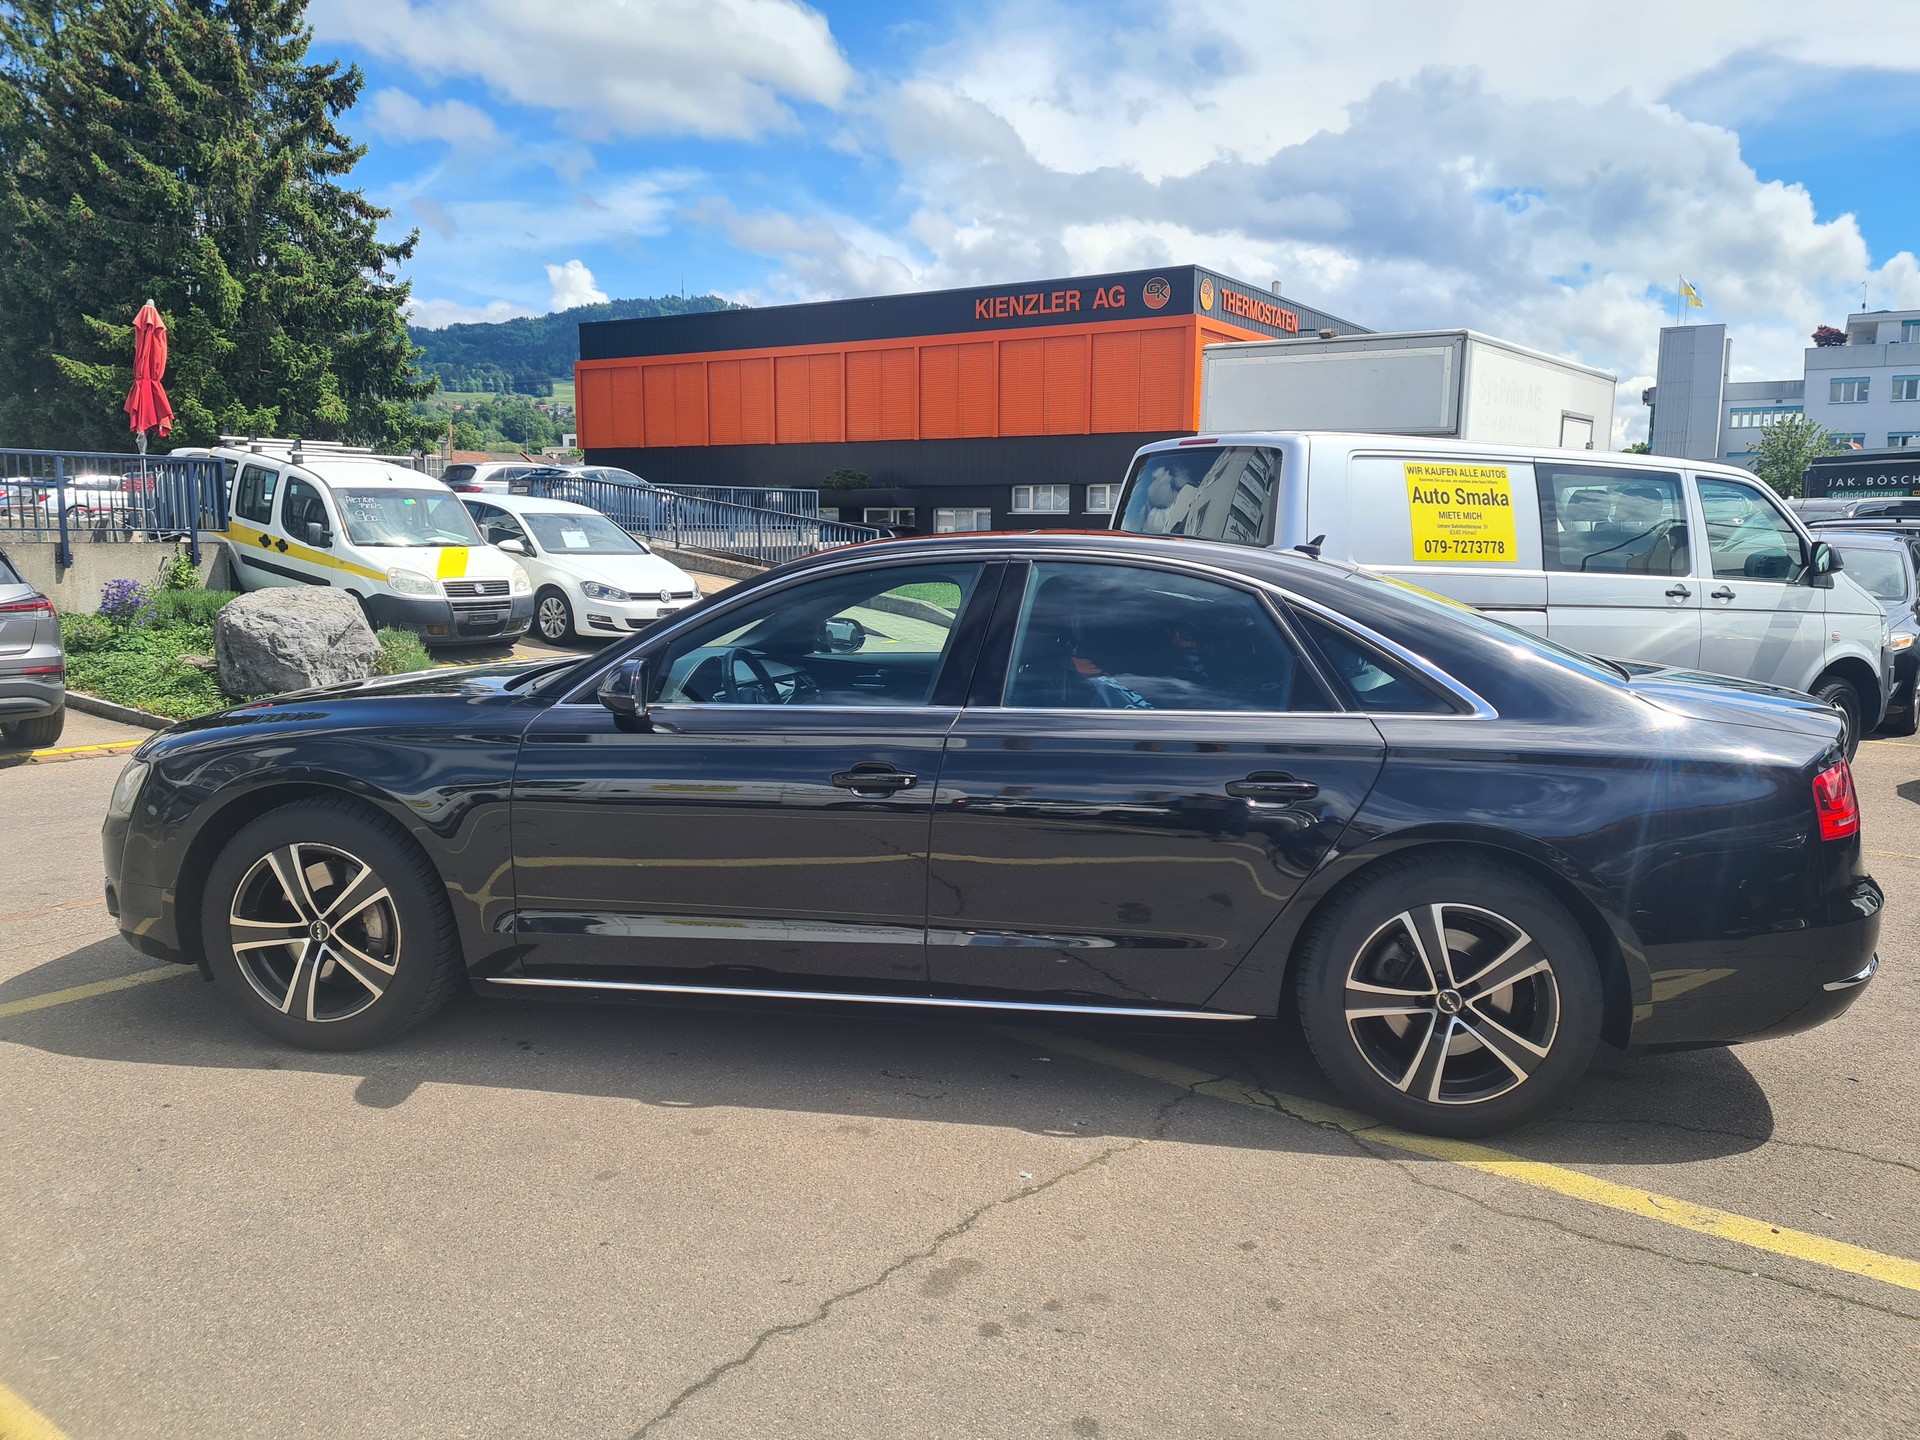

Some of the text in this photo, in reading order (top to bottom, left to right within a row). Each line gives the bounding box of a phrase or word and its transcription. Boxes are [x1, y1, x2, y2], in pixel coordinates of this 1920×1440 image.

[975, 285, 1126, 319] KIENZLER AG
[1220, 287, 1298, 333] THERMOSTATEN
[1406, 466, 1507, 479] WIR KAUFEN ALLE AUTOS
[1827, 478, 1861, 487] JAK.
[1412, 486, 1510, 507] Auto Smaka
[1832, 490, 1903, 499] Geländefahrzeuge
[1438, 511, 1482, 520] MIETE MICH
[1424, 540, 1505, 554] 079-7273778
